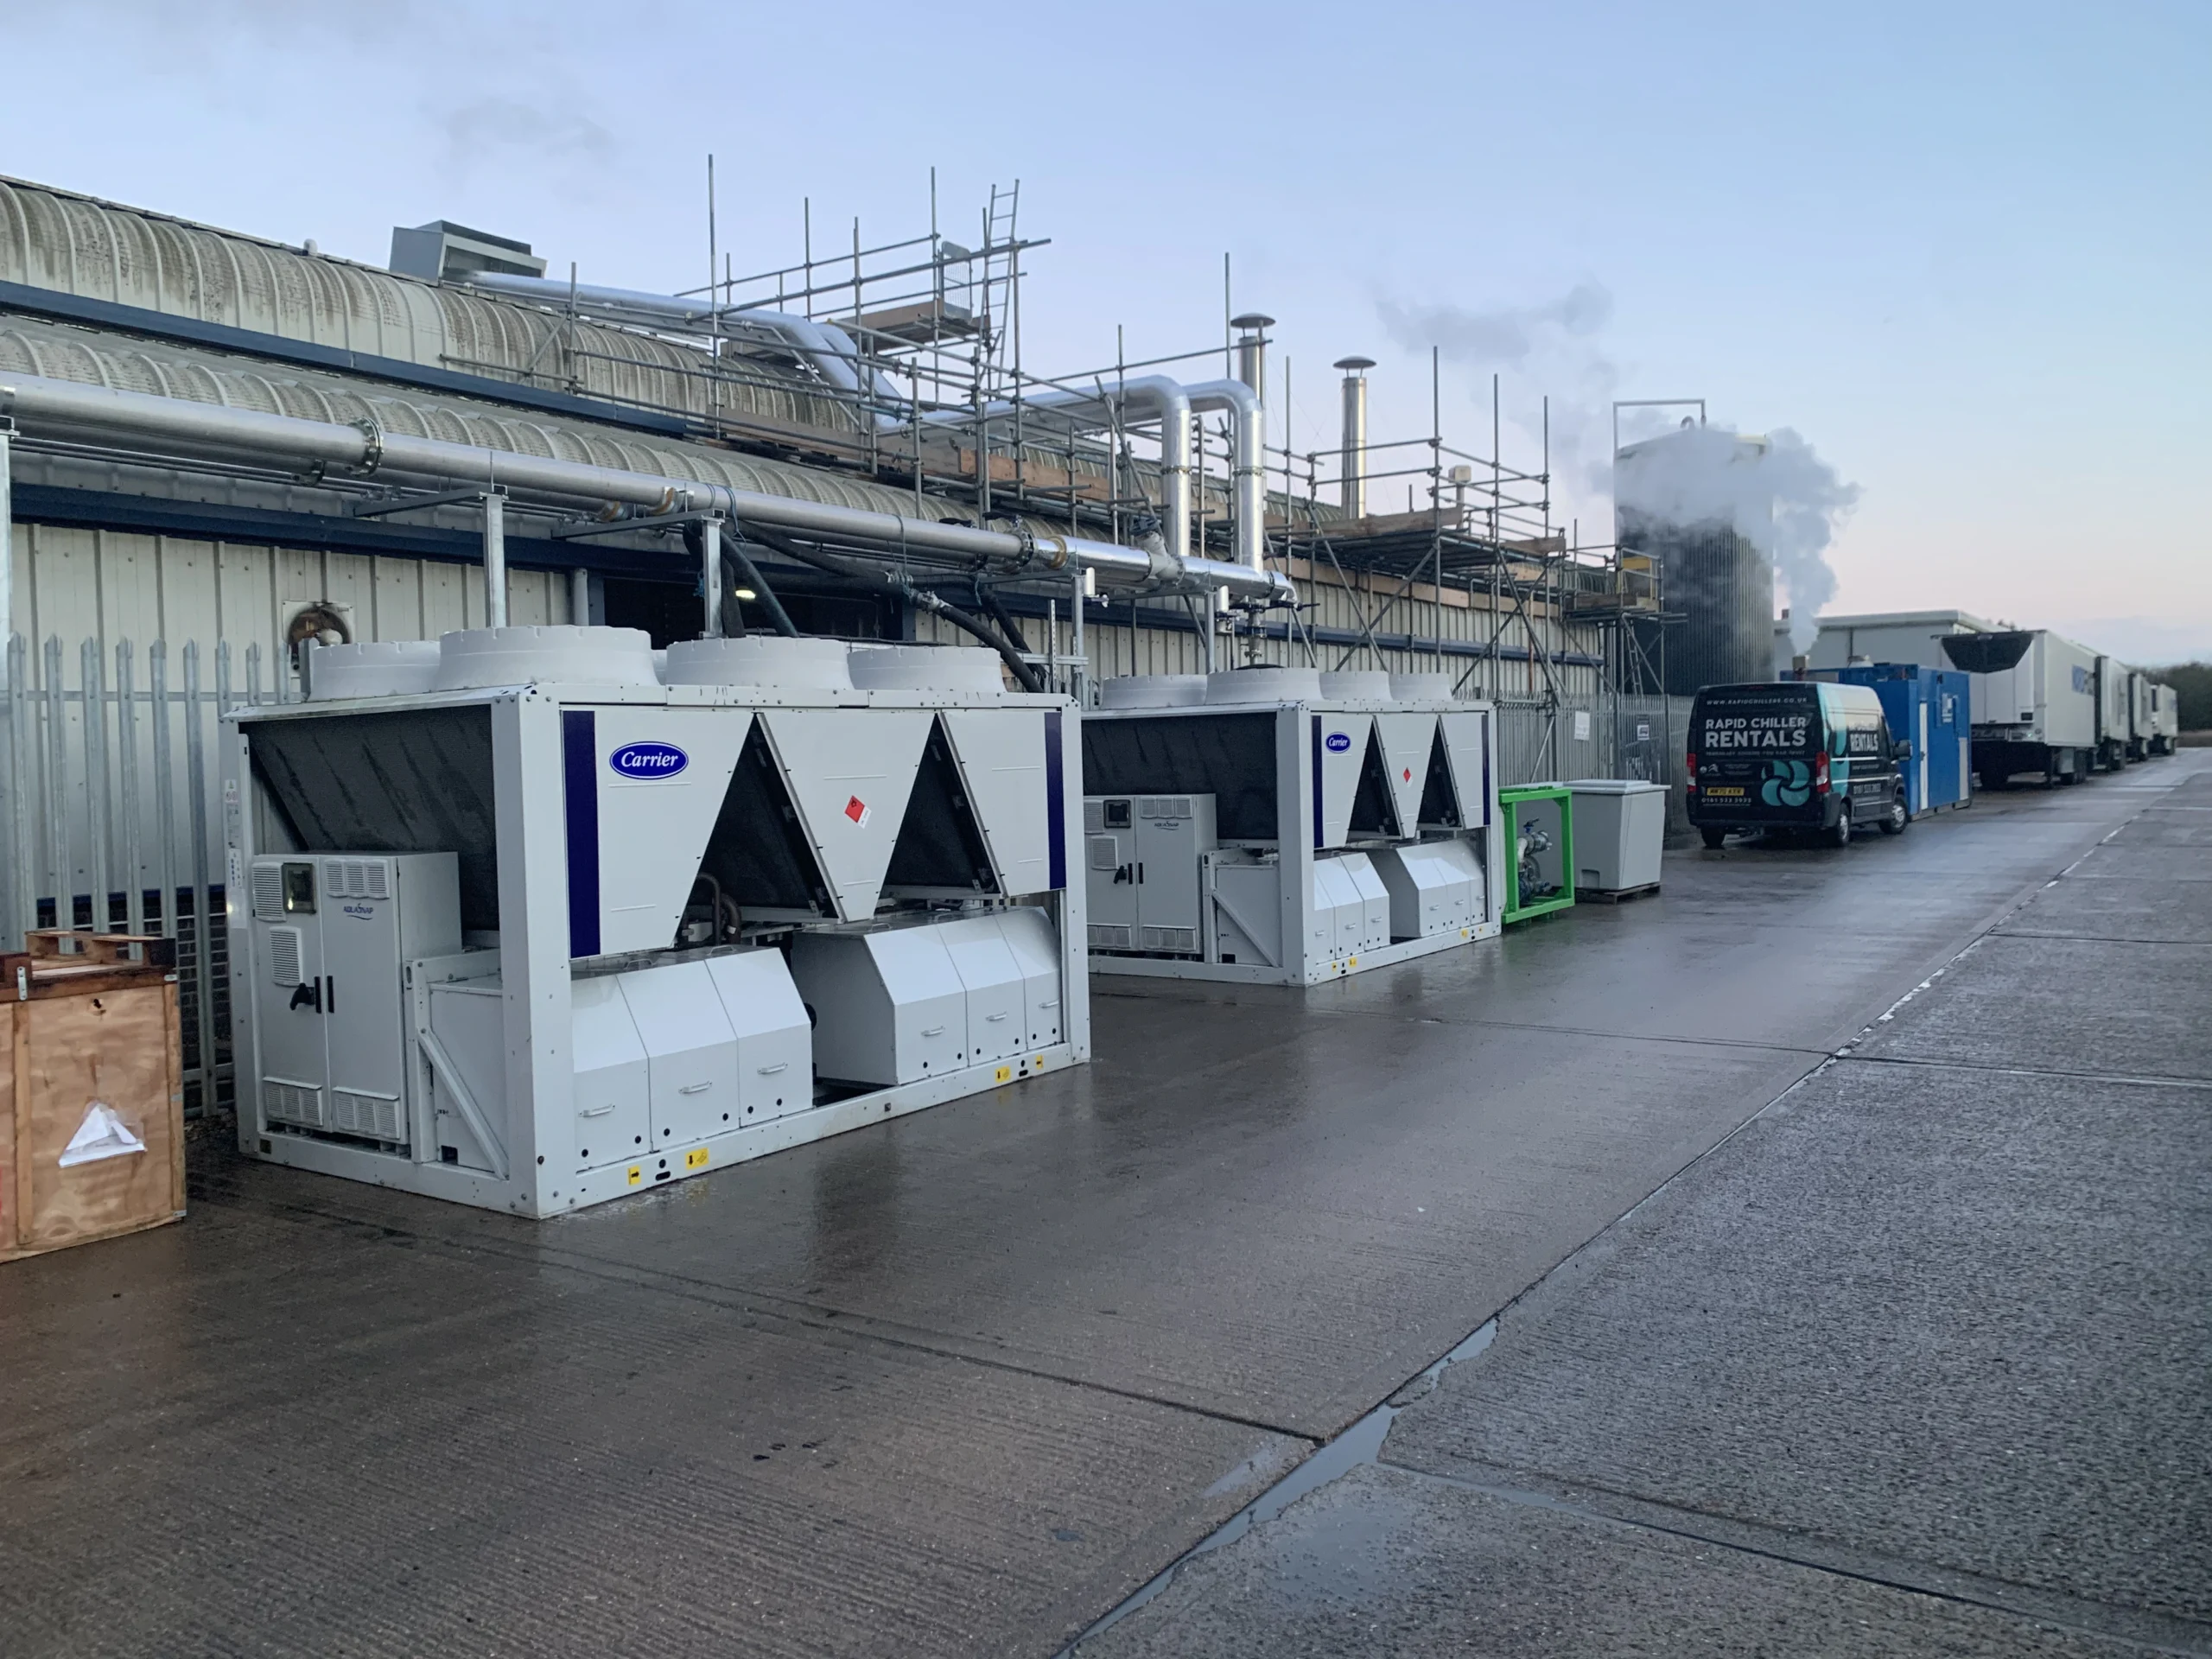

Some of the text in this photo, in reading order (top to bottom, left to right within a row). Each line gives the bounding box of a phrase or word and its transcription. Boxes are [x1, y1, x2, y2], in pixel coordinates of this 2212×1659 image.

[1706, 716, 1807, 729] RAPID CHILLER
[1328, 737, 1348, 747] Carrier
[1706, 729, 1806, 747] RENTALS
[1850, 734, 1878, 752] RENTALS
[620, 751, 679, 767] Carrier
